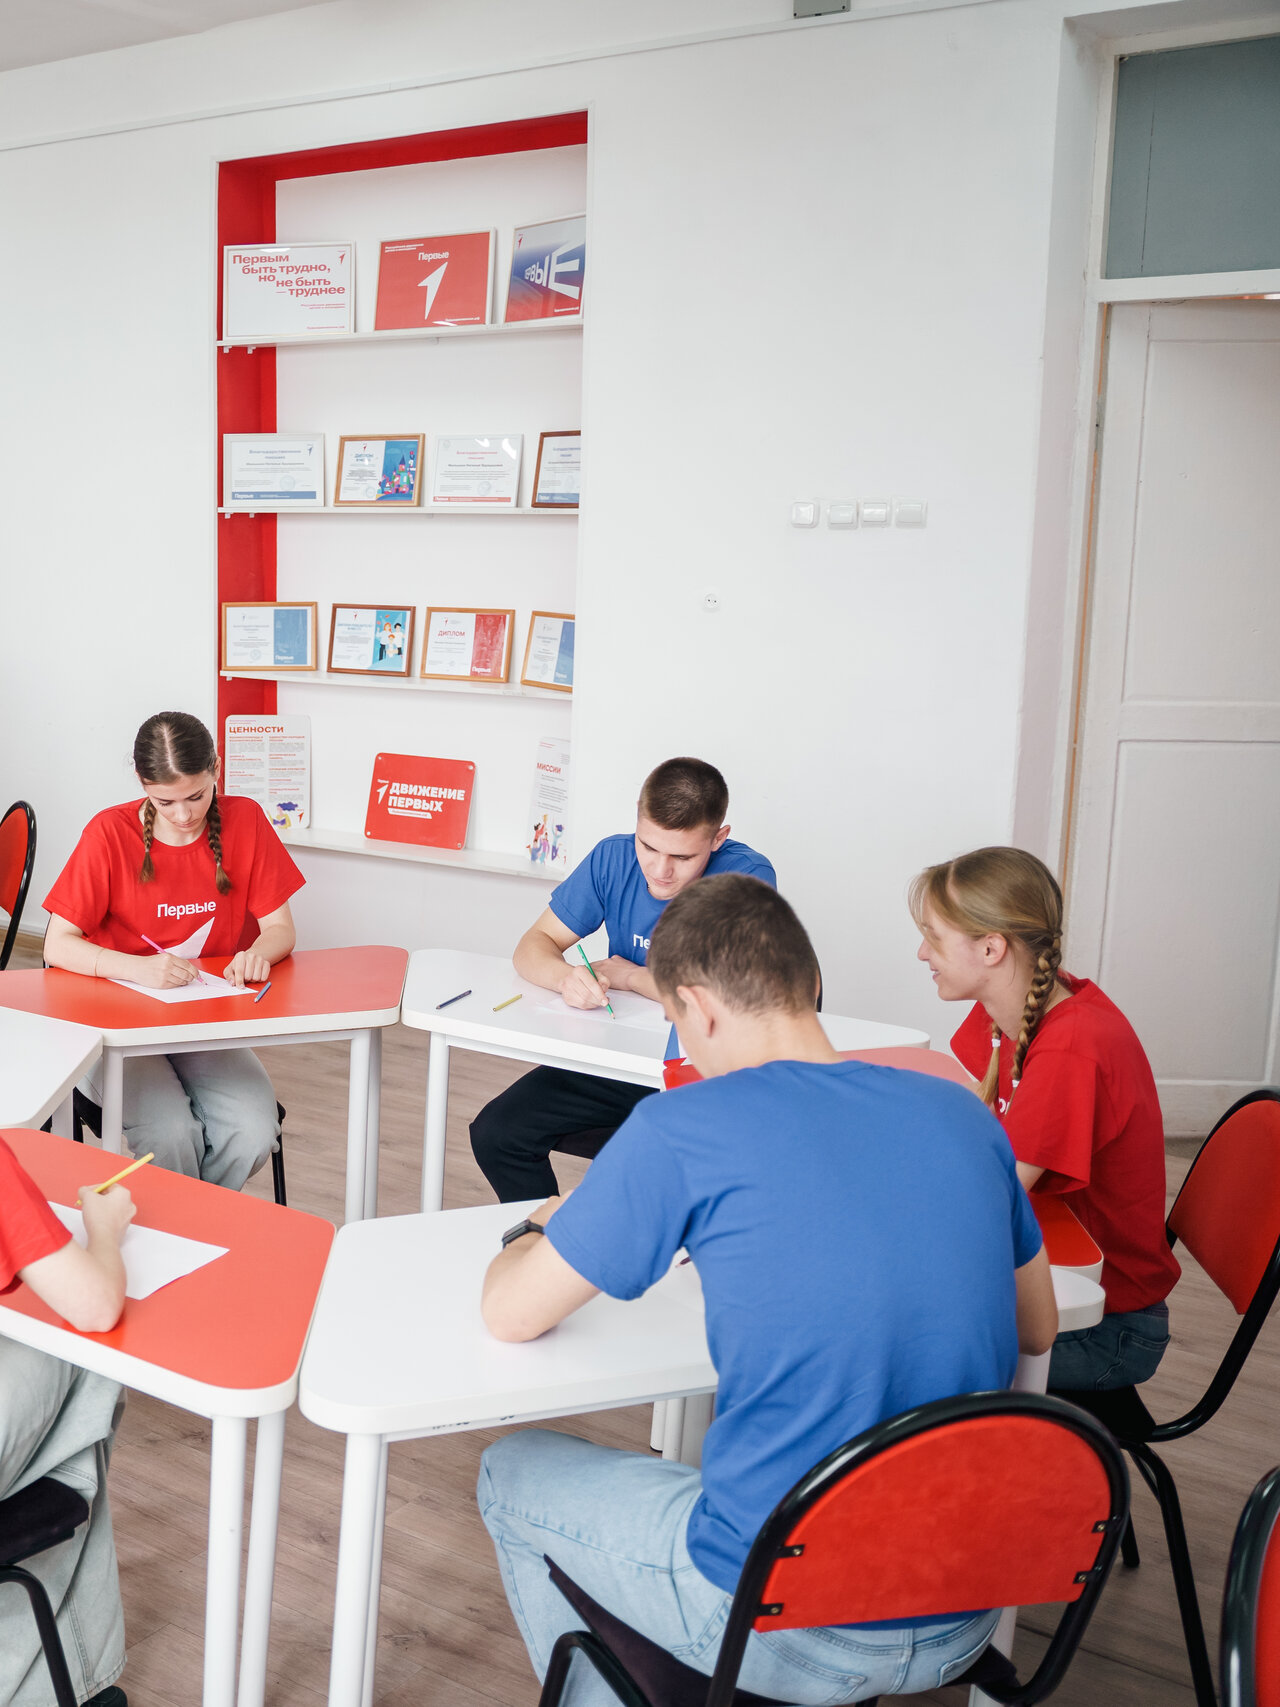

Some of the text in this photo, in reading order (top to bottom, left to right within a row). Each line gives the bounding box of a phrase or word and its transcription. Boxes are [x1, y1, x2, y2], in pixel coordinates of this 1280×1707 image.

[232, 254, 290, 266] Первым
[418, 250, 449, 262] Первые
[242, 264, 331, 274] быть трудно,
[258, 274, 276, 282] но
[276, 276, 331, 287] не быть
[288, 286, 345, 298] труднее
[437, 629, 466, 637] ДИПЛОМ
[229, 726, 284, 734] ЦЕННОСТИ
[536, 762, 562, 774] МИССИИ
[389, 782, 466, 801] ДВИЖЕНИЕ
[387, 795, 444, 813] ПЕРВЫХ
[157, 900, 217, 920] Первые
